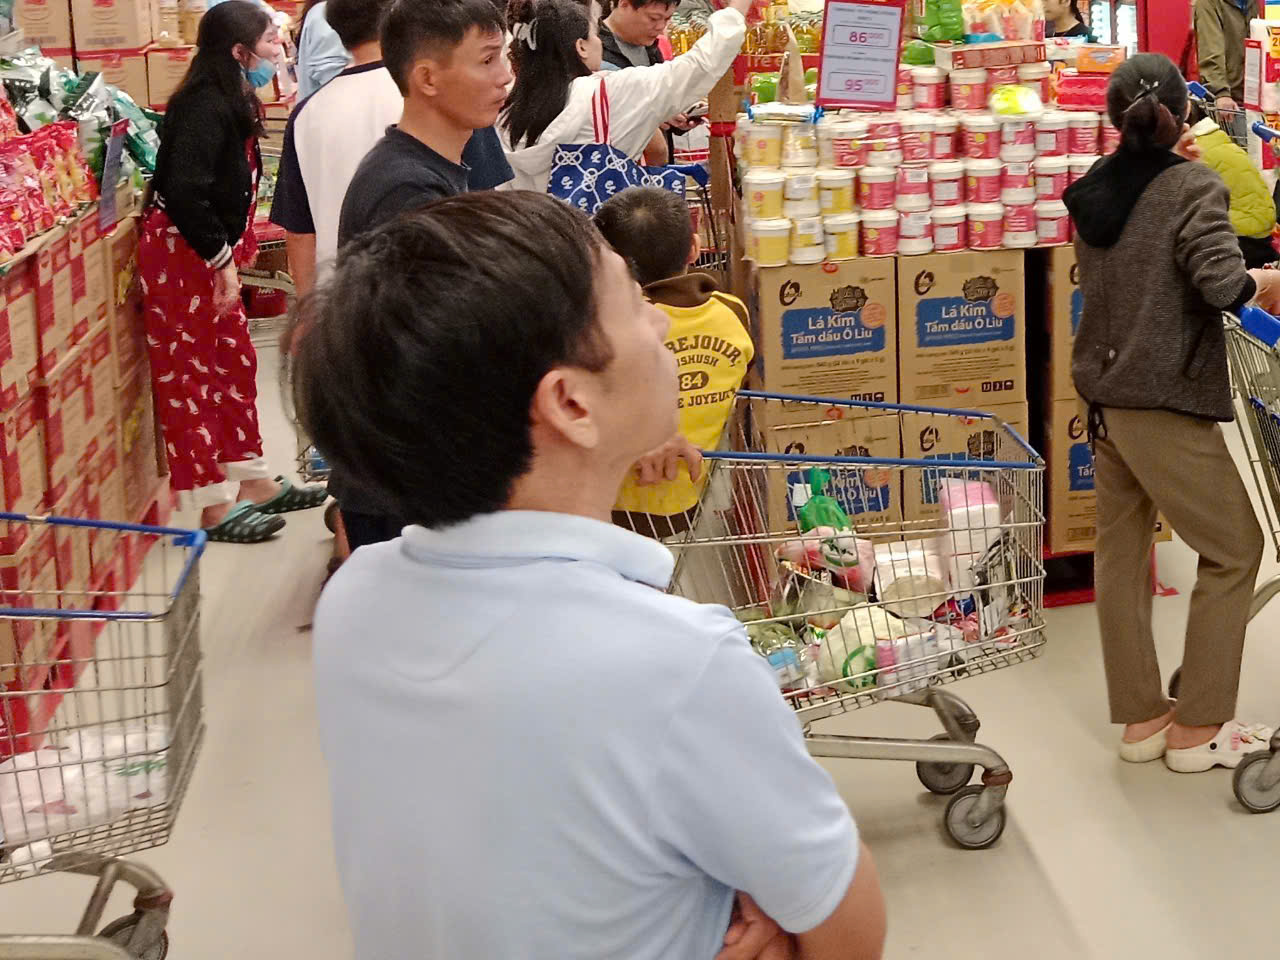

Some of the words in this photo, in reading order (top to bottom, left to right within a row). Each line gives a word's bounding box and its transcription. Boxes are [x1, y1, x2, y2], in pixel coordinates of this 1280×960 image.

[941, 304, 957, 319] Lá
[960, 303, 986, 317] Kim
[808, 315, 825, 330] Lá
[827, 314, 856, 329] Kim
[986, 316, 1003, 328] Liu
[842, 327, 853, 340] Ô
[855, 327, 873, 339] Liu
[681, 373, 703, 390] 84
